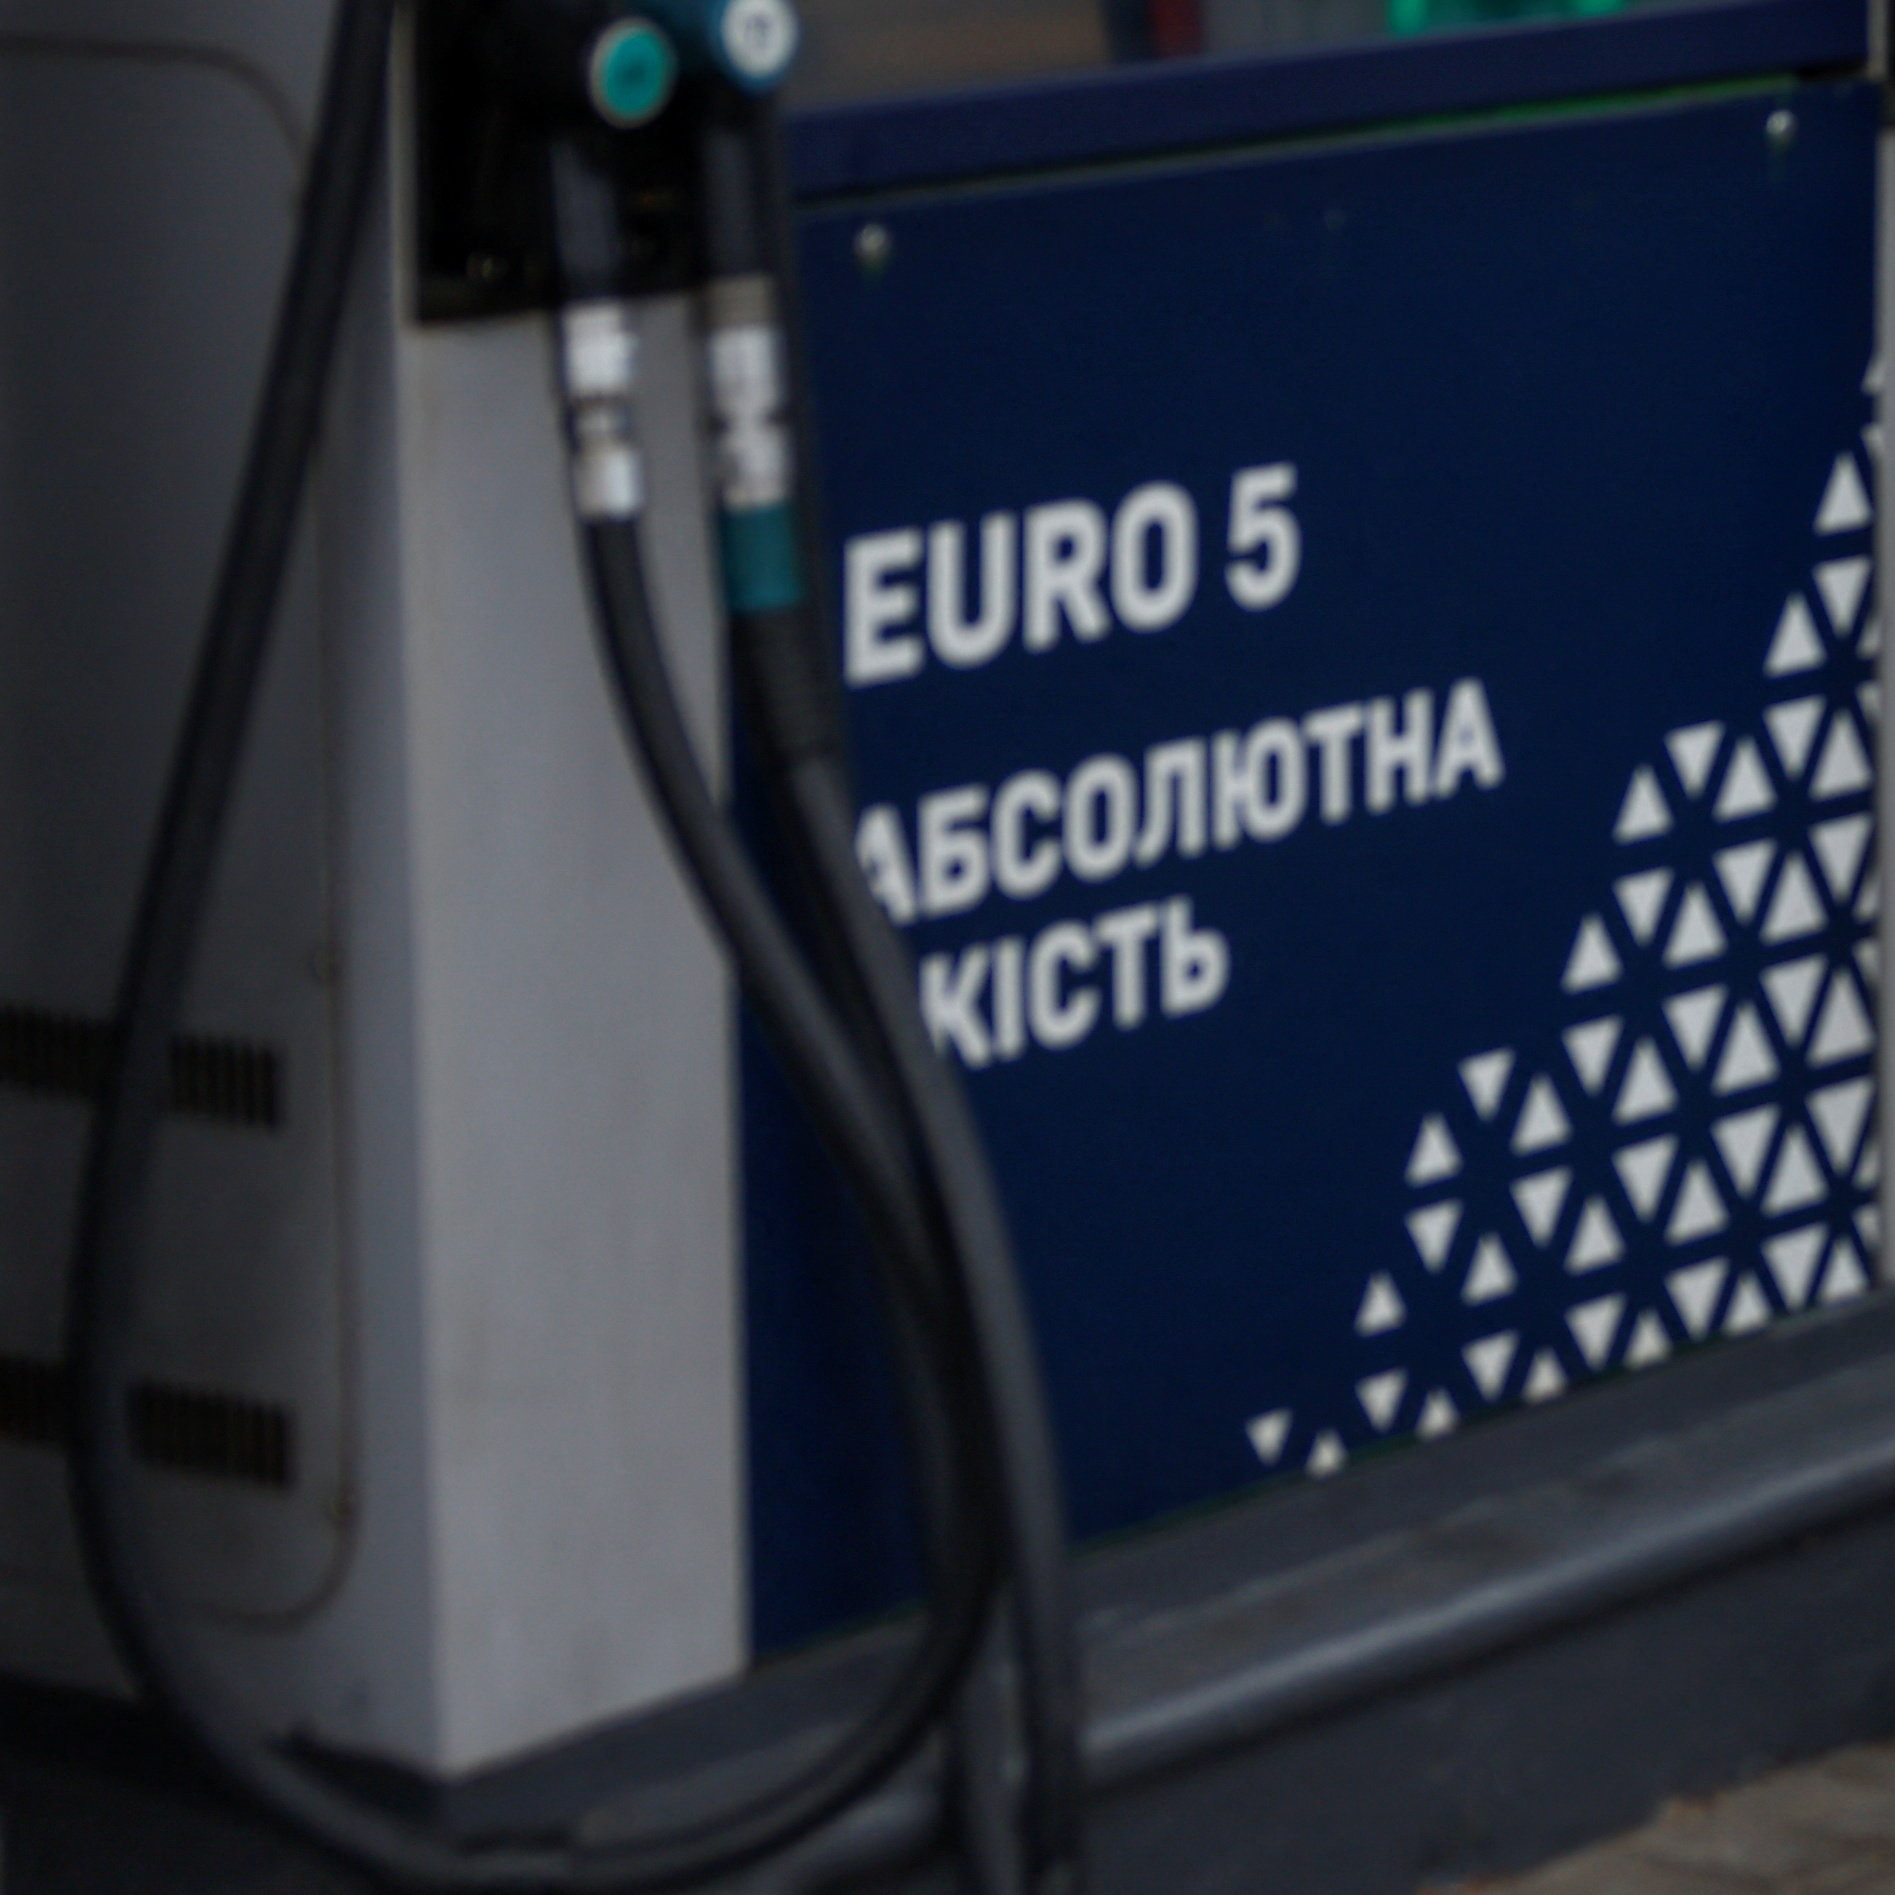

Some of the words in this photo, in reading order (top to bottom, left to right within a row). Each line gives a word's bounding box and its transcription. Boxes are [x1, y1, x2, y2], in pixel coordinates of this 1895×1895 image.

[844, 482, 1199, 688] EURO
[1224, 461, 1303, 610] 5
[854, 677, 1505, 925] АБСОЛЮТНА
[918, 897, 1231, 1070] КІСТЬ
